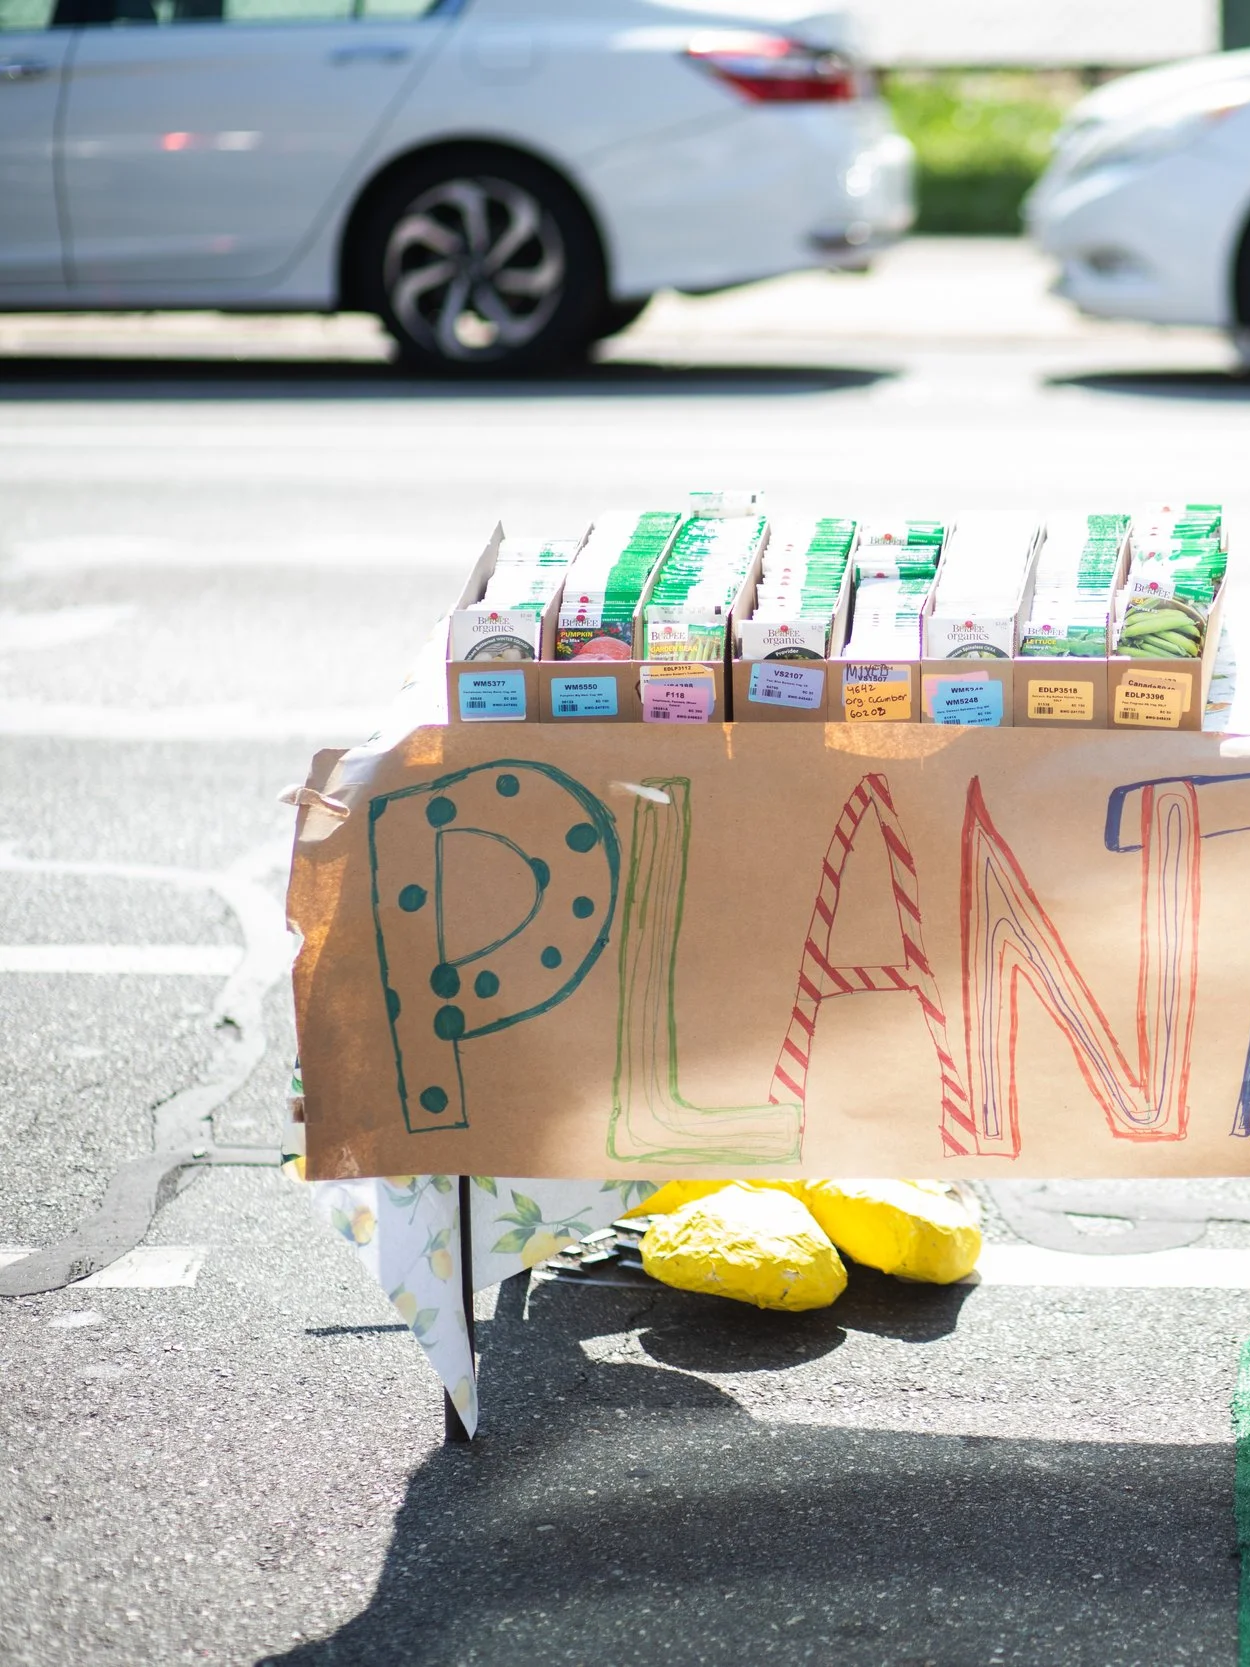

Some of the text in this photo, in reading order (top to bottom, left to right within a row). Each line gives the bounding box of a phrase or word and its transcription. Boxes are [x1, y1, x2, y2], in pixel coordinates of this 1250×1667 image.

[472, 624, 514, 633] organics
[763, 637, 805, 645] organics
[947, 633, 989, 642] organics
[774, 670, 803, 679] VS2107
[847, 685, 876, 694] 4642
[1125, 692, 1164, 700] EDLP3396
[946, 697, 979, 706] WM5248
